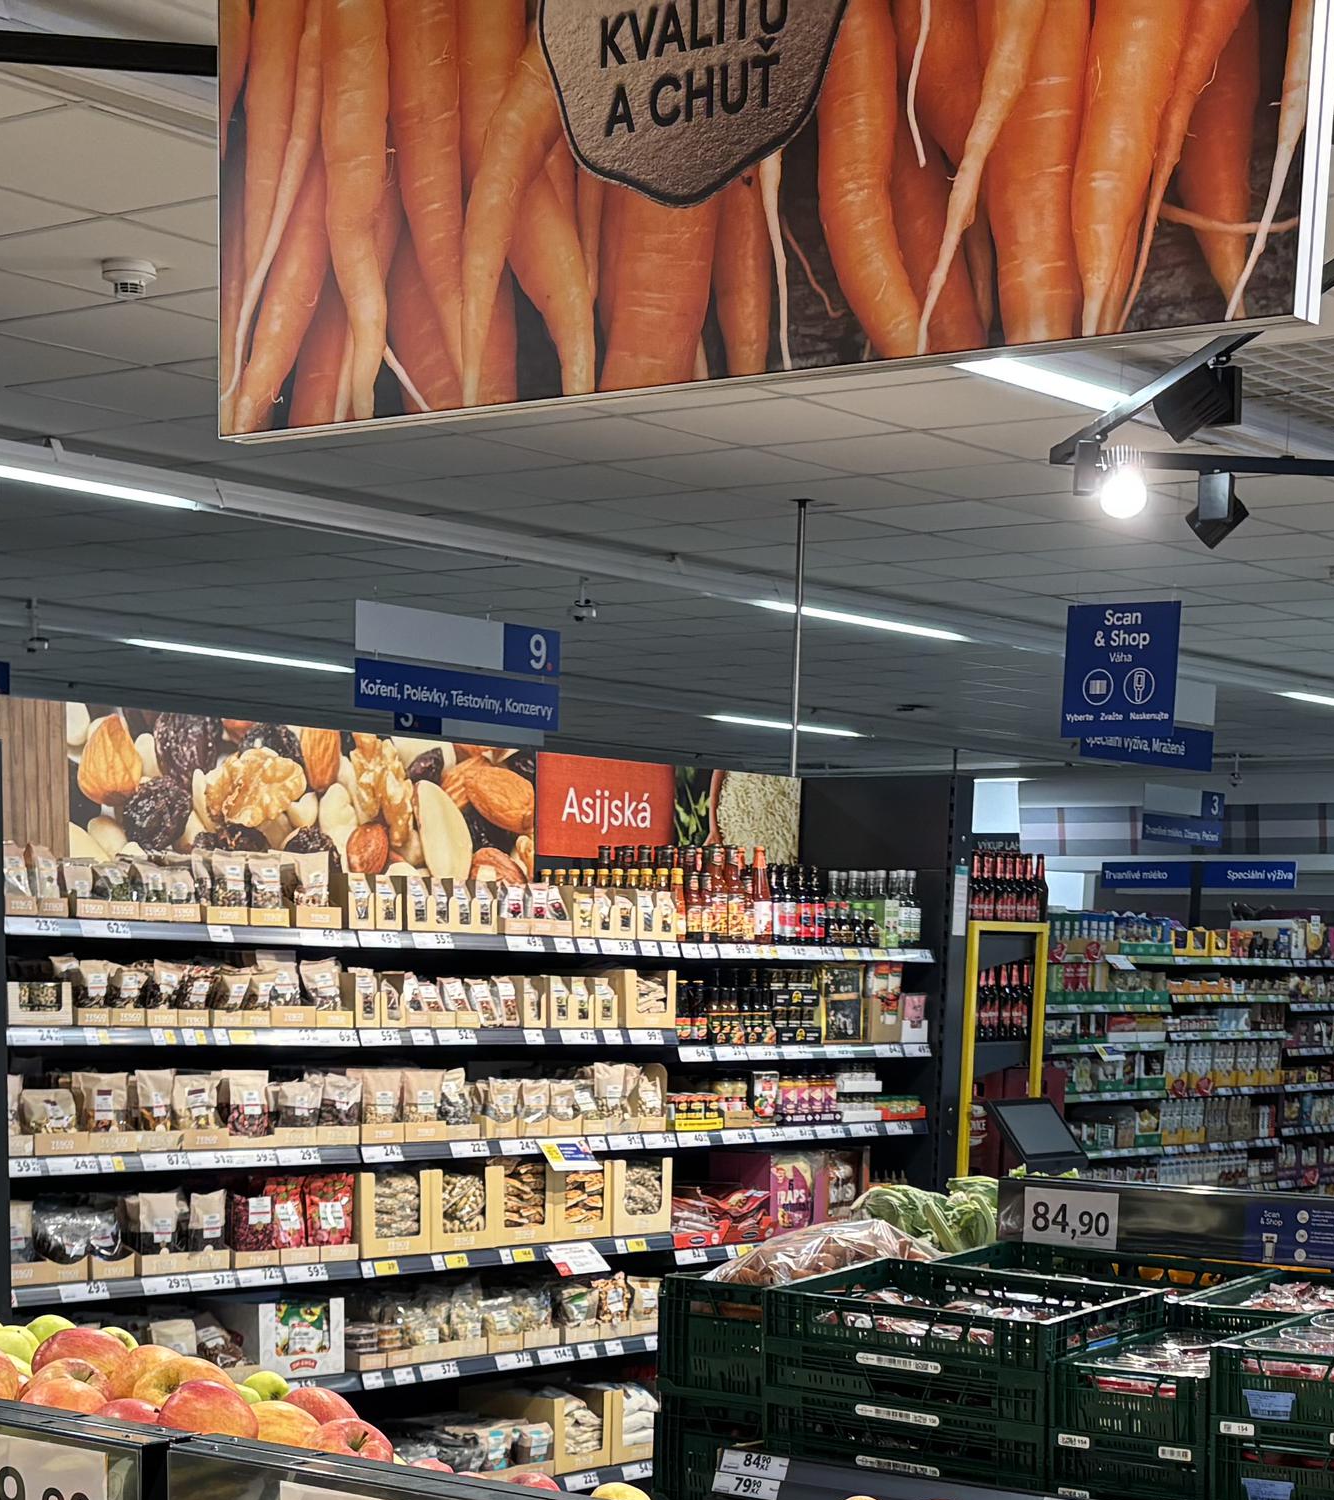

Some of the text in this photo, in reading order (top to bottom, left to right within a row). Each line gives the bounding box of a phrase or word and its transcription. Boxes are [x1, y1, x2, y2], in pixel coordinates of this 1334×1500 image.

[605, 36, 781, 137] A CHUŤ
[1104, 609, 1142, 626] Scan
[1094, 629, 1150, 649] & Shop
[1109, 652, 1132, 663] Váha
[360, 678, 554, 721] Koření, Polévky, Těstoviny, Konzervy
[1066, 713, 1094, 723] Vyberte
[1129, 712, 1169, 721] Naskenujte
[1152, 737, 1187, 756] Mražené
[561, 786, 652, 830] Asijská
[1103, 869, 1169, 881] Trvanlivé mléko
[1226, 868, 1294, 882] Speciální výživa
[1031, 1201, 1110, 1240] 84,90
[743, 1453, 761, 1468] 84
[734, 1477, 751, 1493] 79
